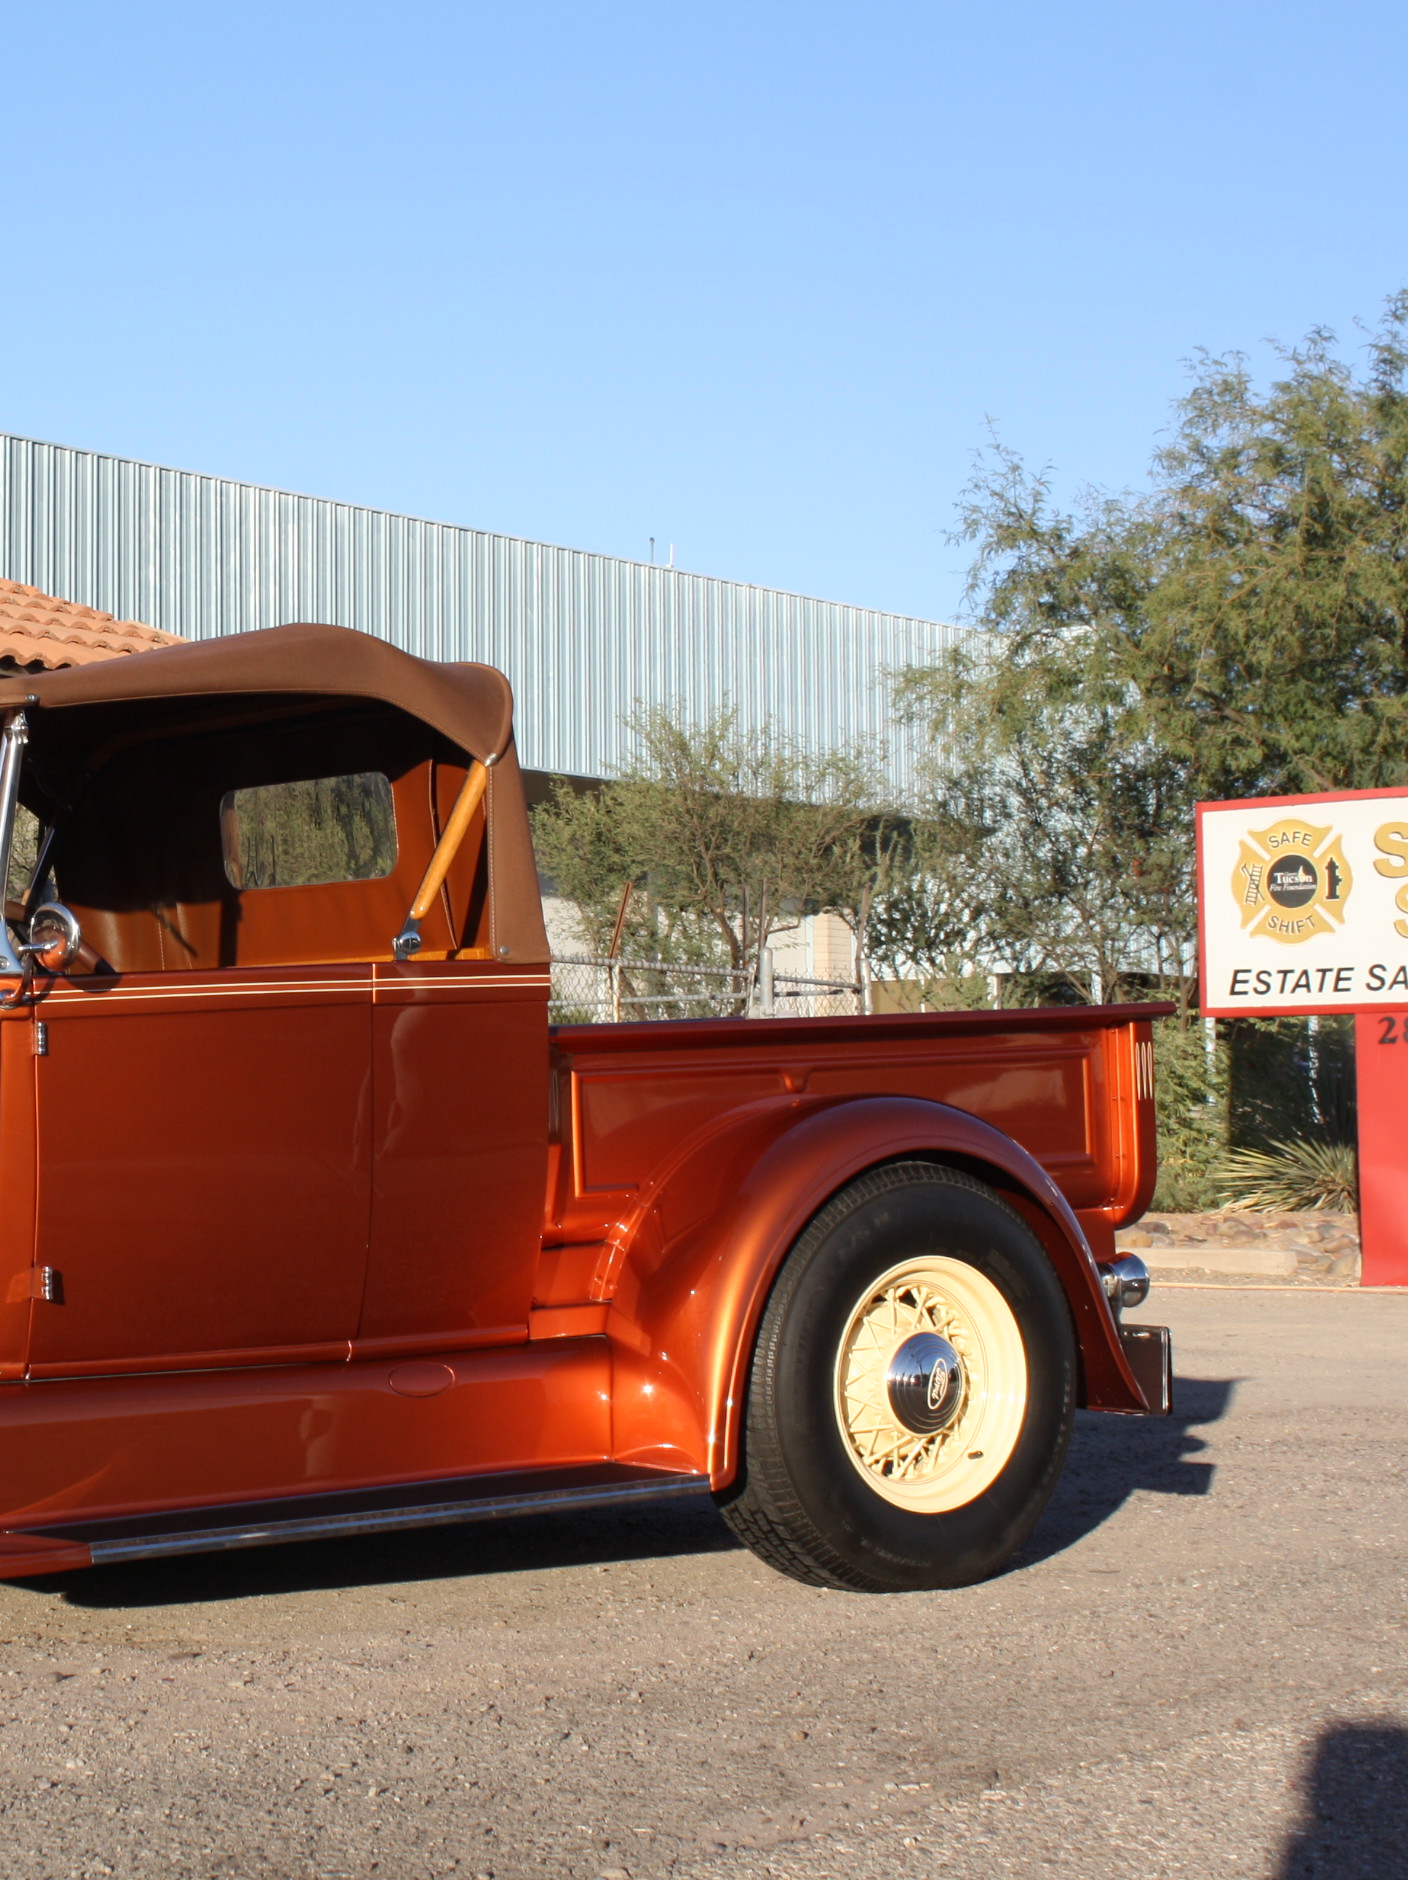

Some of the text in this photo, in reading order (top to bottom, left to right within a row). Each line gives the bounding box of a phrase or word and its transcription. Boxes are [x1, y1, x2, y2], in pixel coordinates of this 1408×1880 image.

[1268, 831, 1313, 848] SAFE
[1273, 871, 1314, 884] Tucson
[1268, 915, 1315, 934] SHIFT
[1229, 963, 1408, 996] ESTATE SA
[1377, 1015, 1408, 1045] 2
[932, 1367, 946, 1400] Ford
